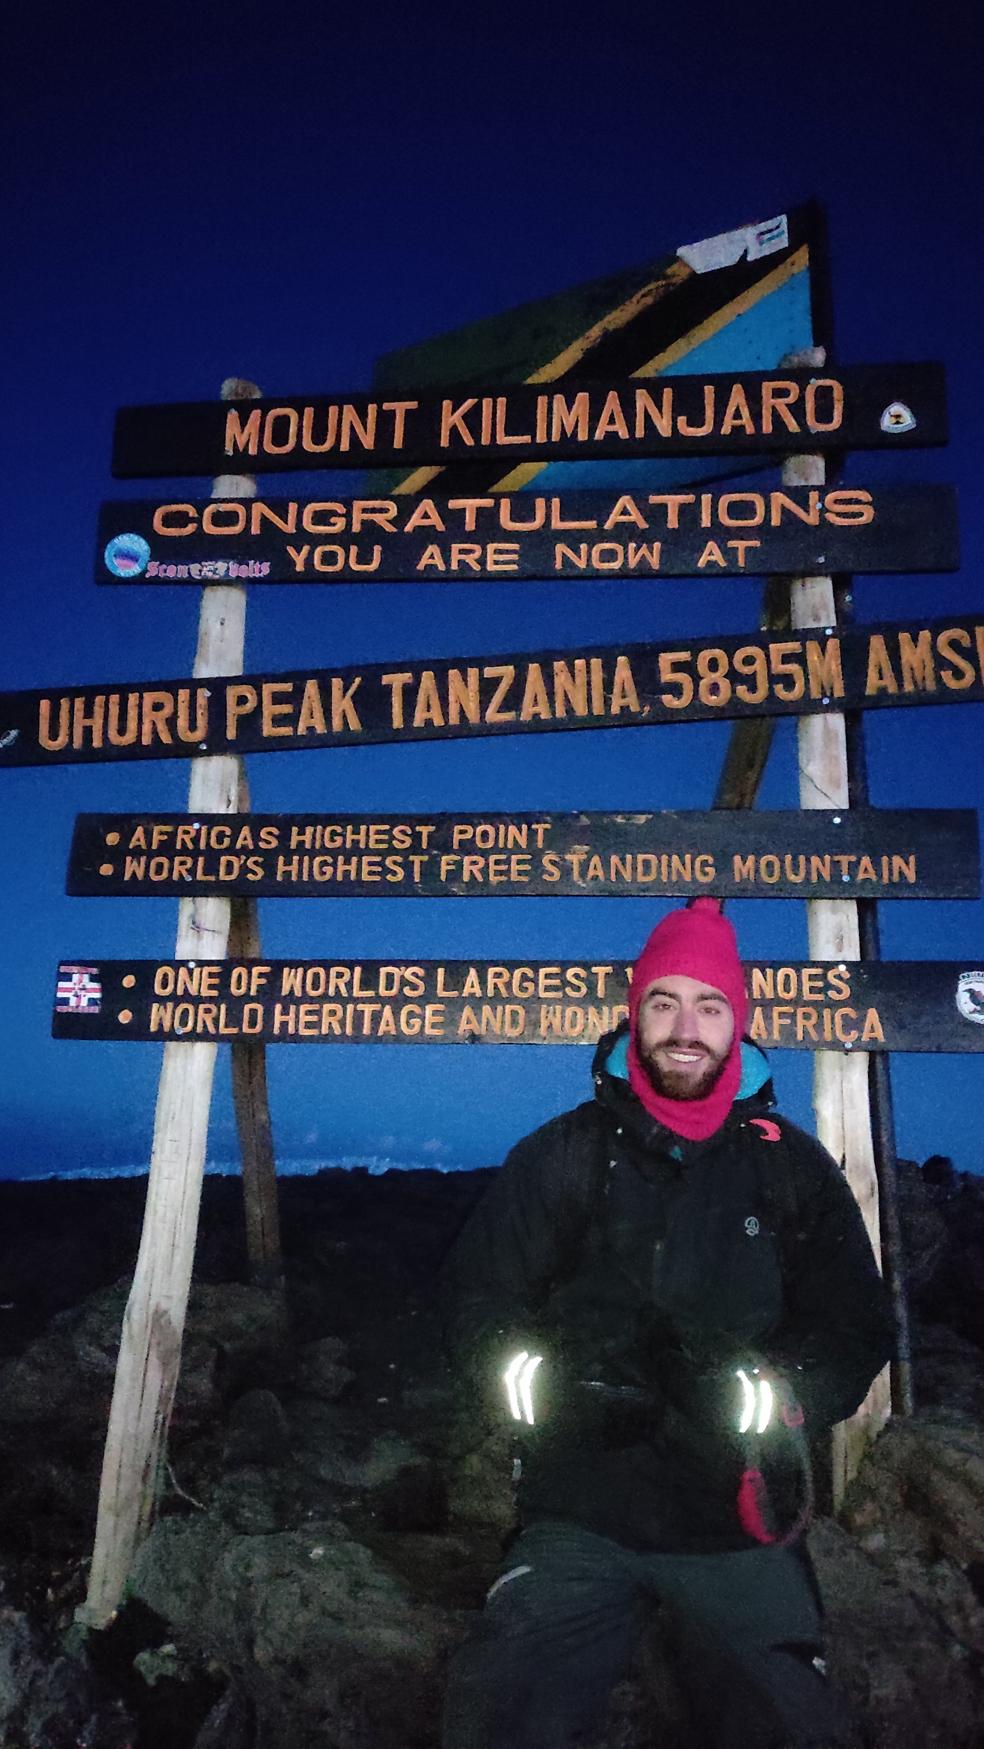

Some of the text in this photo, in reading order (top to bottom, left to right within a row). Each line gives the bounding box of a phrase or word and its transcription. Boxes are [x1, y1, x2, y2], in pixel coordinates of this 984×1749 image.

[224, 378, 845, 456] MOUNT KILIMANJARO
[152, 490, 875, 536] CONGRATULATIONS
[286, 540, 761, 573] YOU ARE NOW AT
[38, 687, 209, 750] UHURU
[225, 676, 362, 741] PEAK
[658, 638, 845, 709] 5895M
[289, 825, 435, 849] HIGHEST
[452, 823, 551, 849] POINT
[123, 853, 917, 884] WORLD'S HIGHEST FREE STANDING MOUNTAIN
[154, 966, 224, 997] ONE
[230, 966, 271, 996] OF
[281, 966, 425, 998] WORLD'S
[436, 966, 614, 998] LARGEST
[150, 1002, 264, 1034] WORLD
[273, 1003, 445, 1036] HERITAGE
[458, 1005, 526, 1036] AND
[750, 1006, 886, 1043] AFRICA
